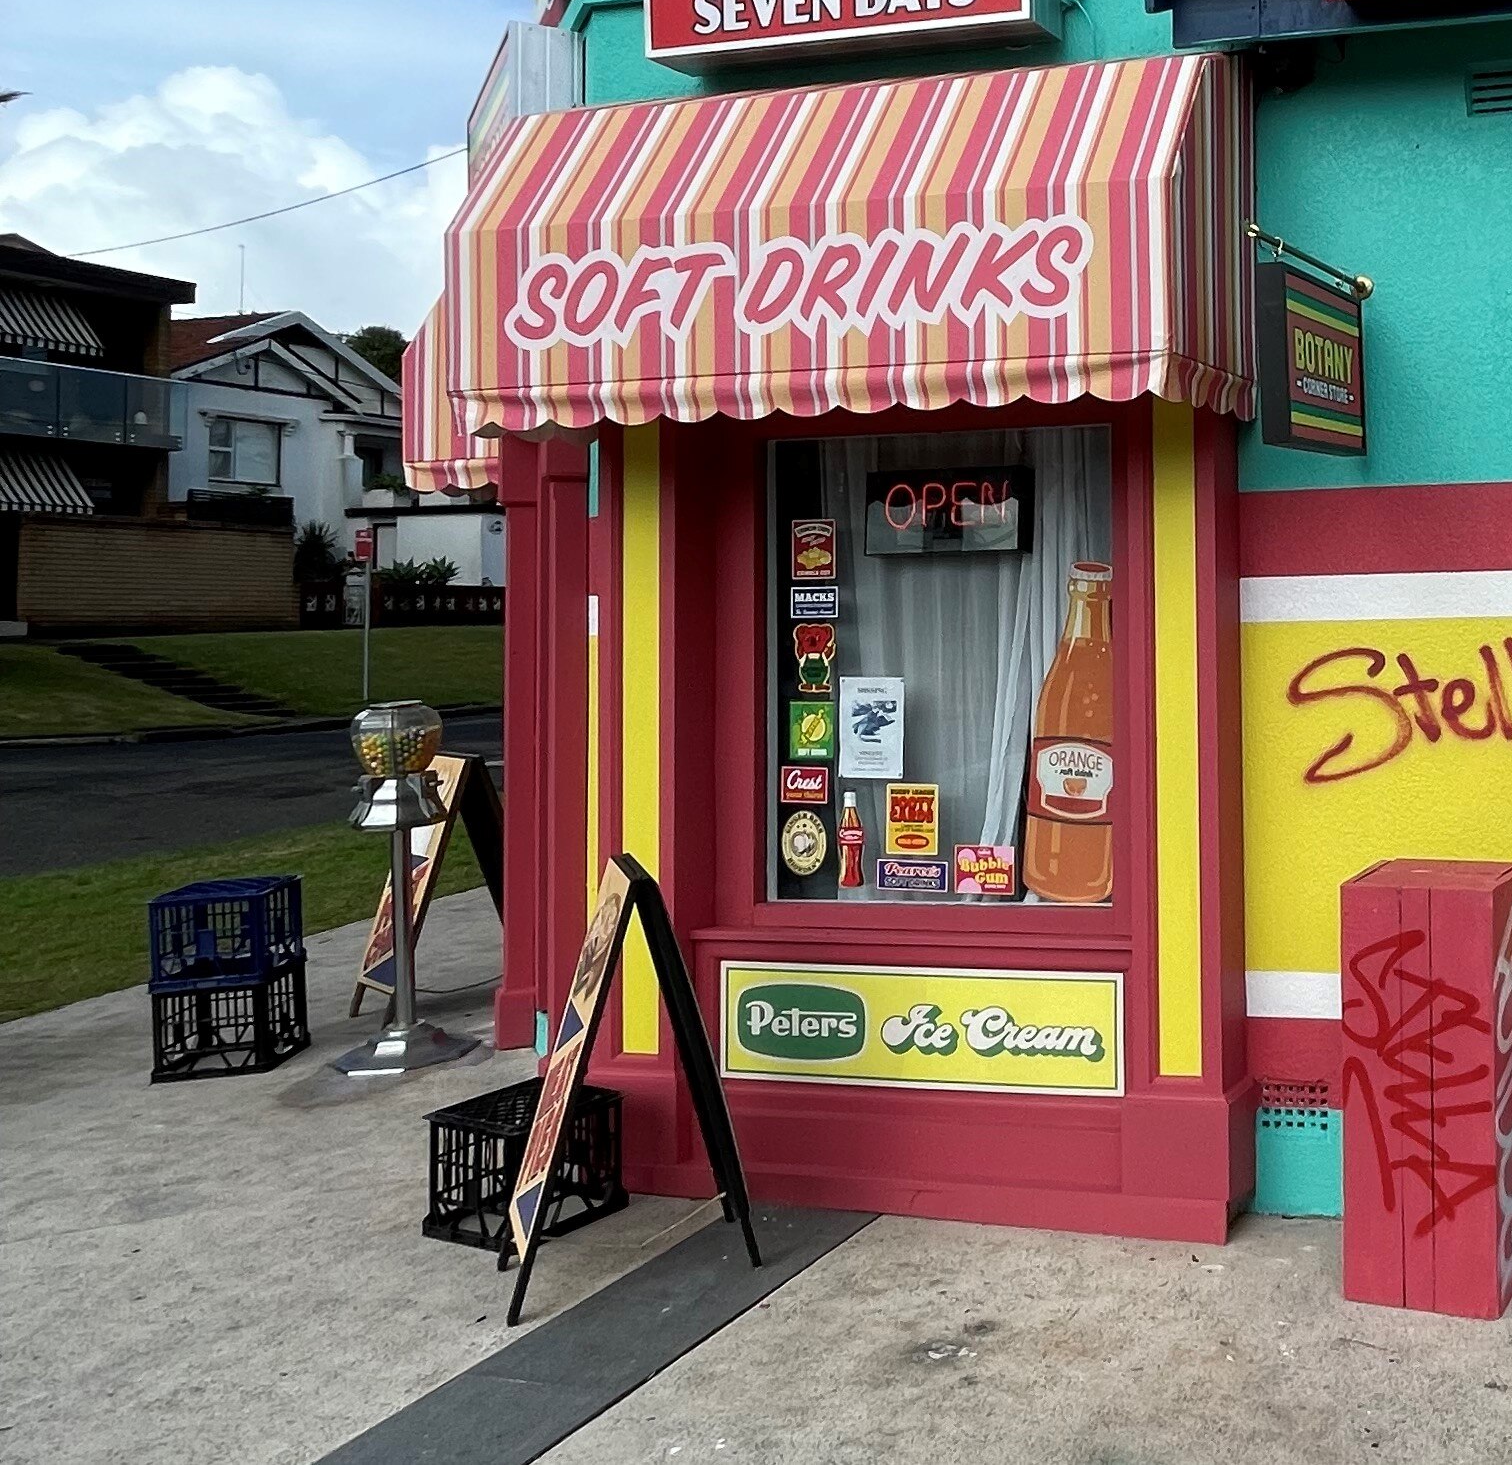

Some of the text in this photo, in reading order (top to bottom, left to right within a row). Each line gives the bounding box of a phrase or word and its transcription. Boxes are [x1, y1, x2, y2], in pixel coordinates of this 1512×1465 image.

[510, 222, 1085, 343] SOFT DRINKS
[1293, 326, 1354, 385] BOTANY
[885, 480, 1009, 530] OPEN
[794, 592, 835, 603] MACKS
[1048, 750, 1103, 772] ORANGE
[786, 769, 823, 790] Crest
[960, 856, 1010, 873] Bubble
[974, 871, 1009, 885] Gum
[746, 1000, 1104, 1062] Peters Ice Cream
